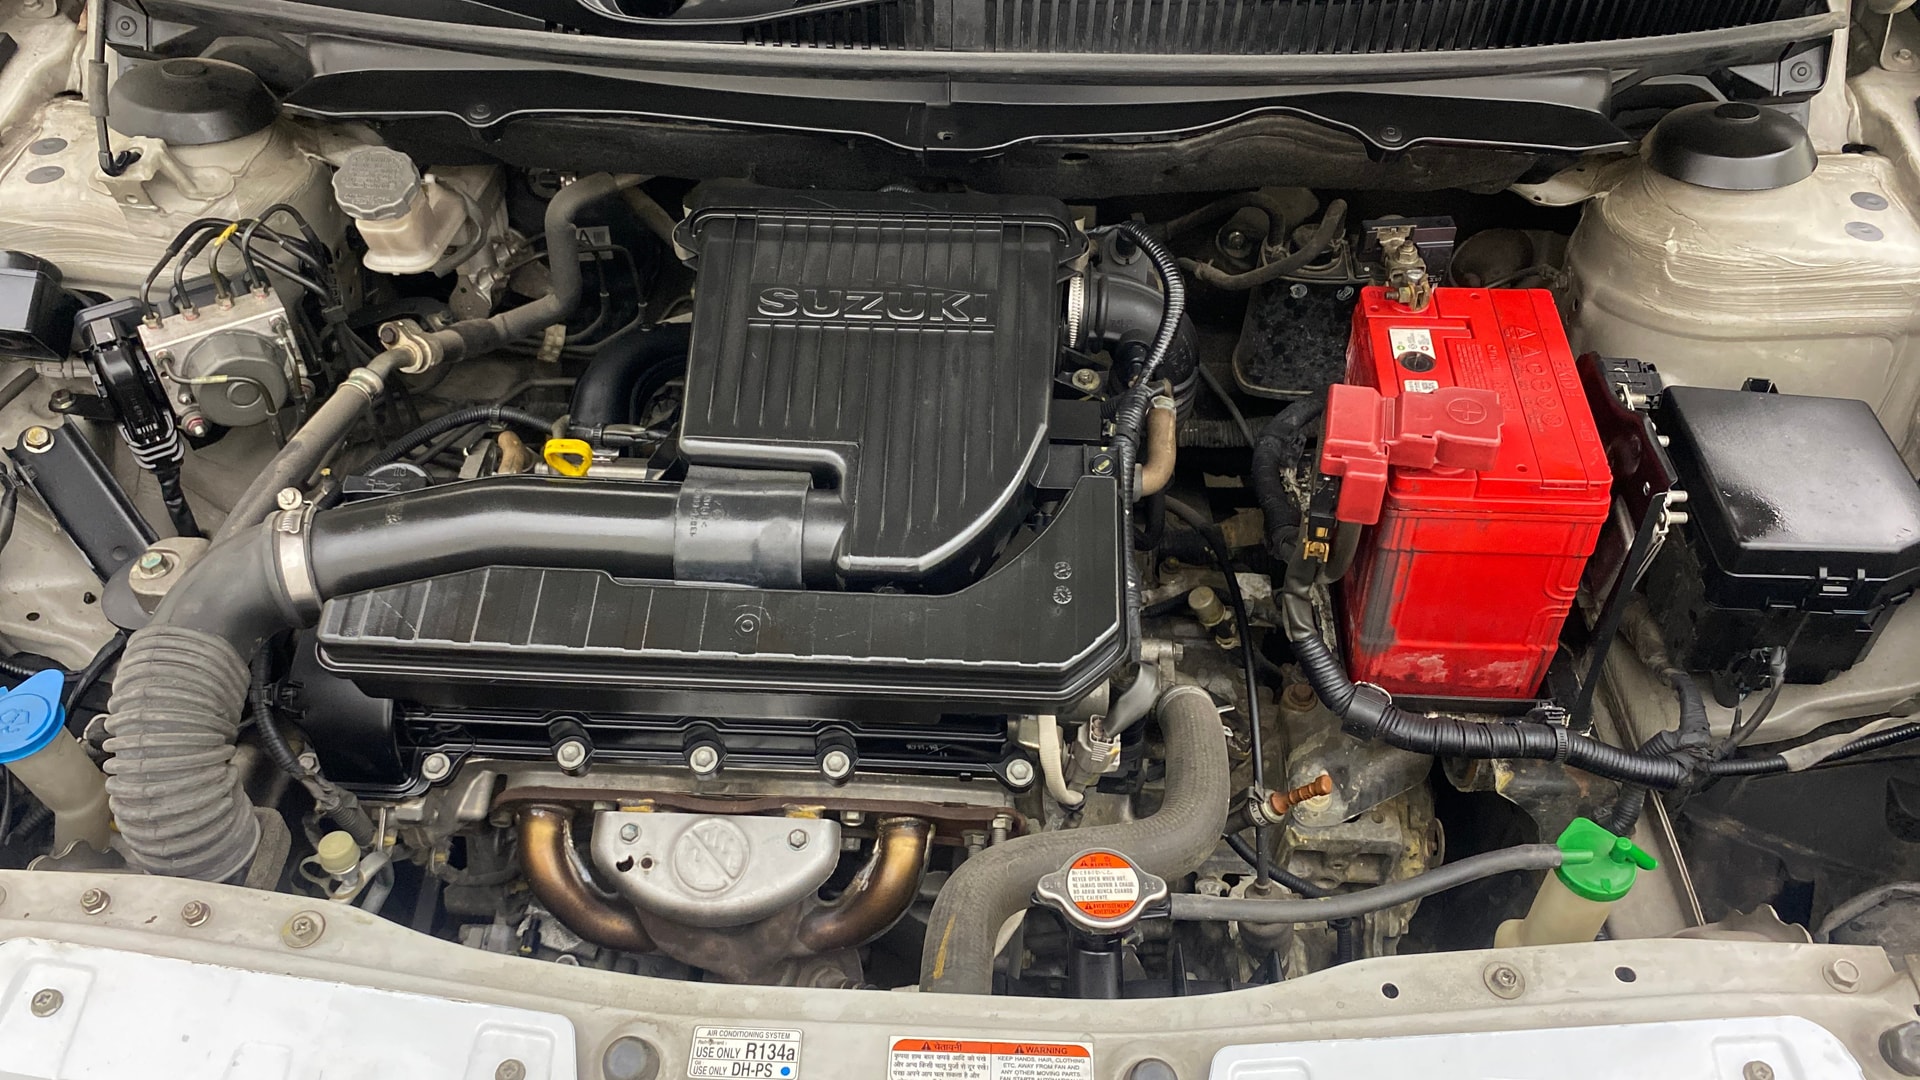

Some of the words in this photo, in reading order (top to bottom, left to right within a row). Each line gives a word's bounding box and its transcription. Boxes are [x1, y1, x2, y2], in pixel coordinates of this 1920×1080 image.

[719, 1030, 764, 1038] CONDITIONING
[765, 1031, 791, 1039] SYSTEM
[934, 1041, 962, 1051] चेतावनी
[1025, 1046, 1068, 1055] WARNING
[696, 1046, 714, 1058] USE
[716, 1047, 741, 1059] ONLY
[745, 1042, 795, 1061] R134a
[693, 1066, 708, 1075] USE
[708, 1066, 727, 1076] ONLY
[732, 1062, 773, 1078] DH-PS
